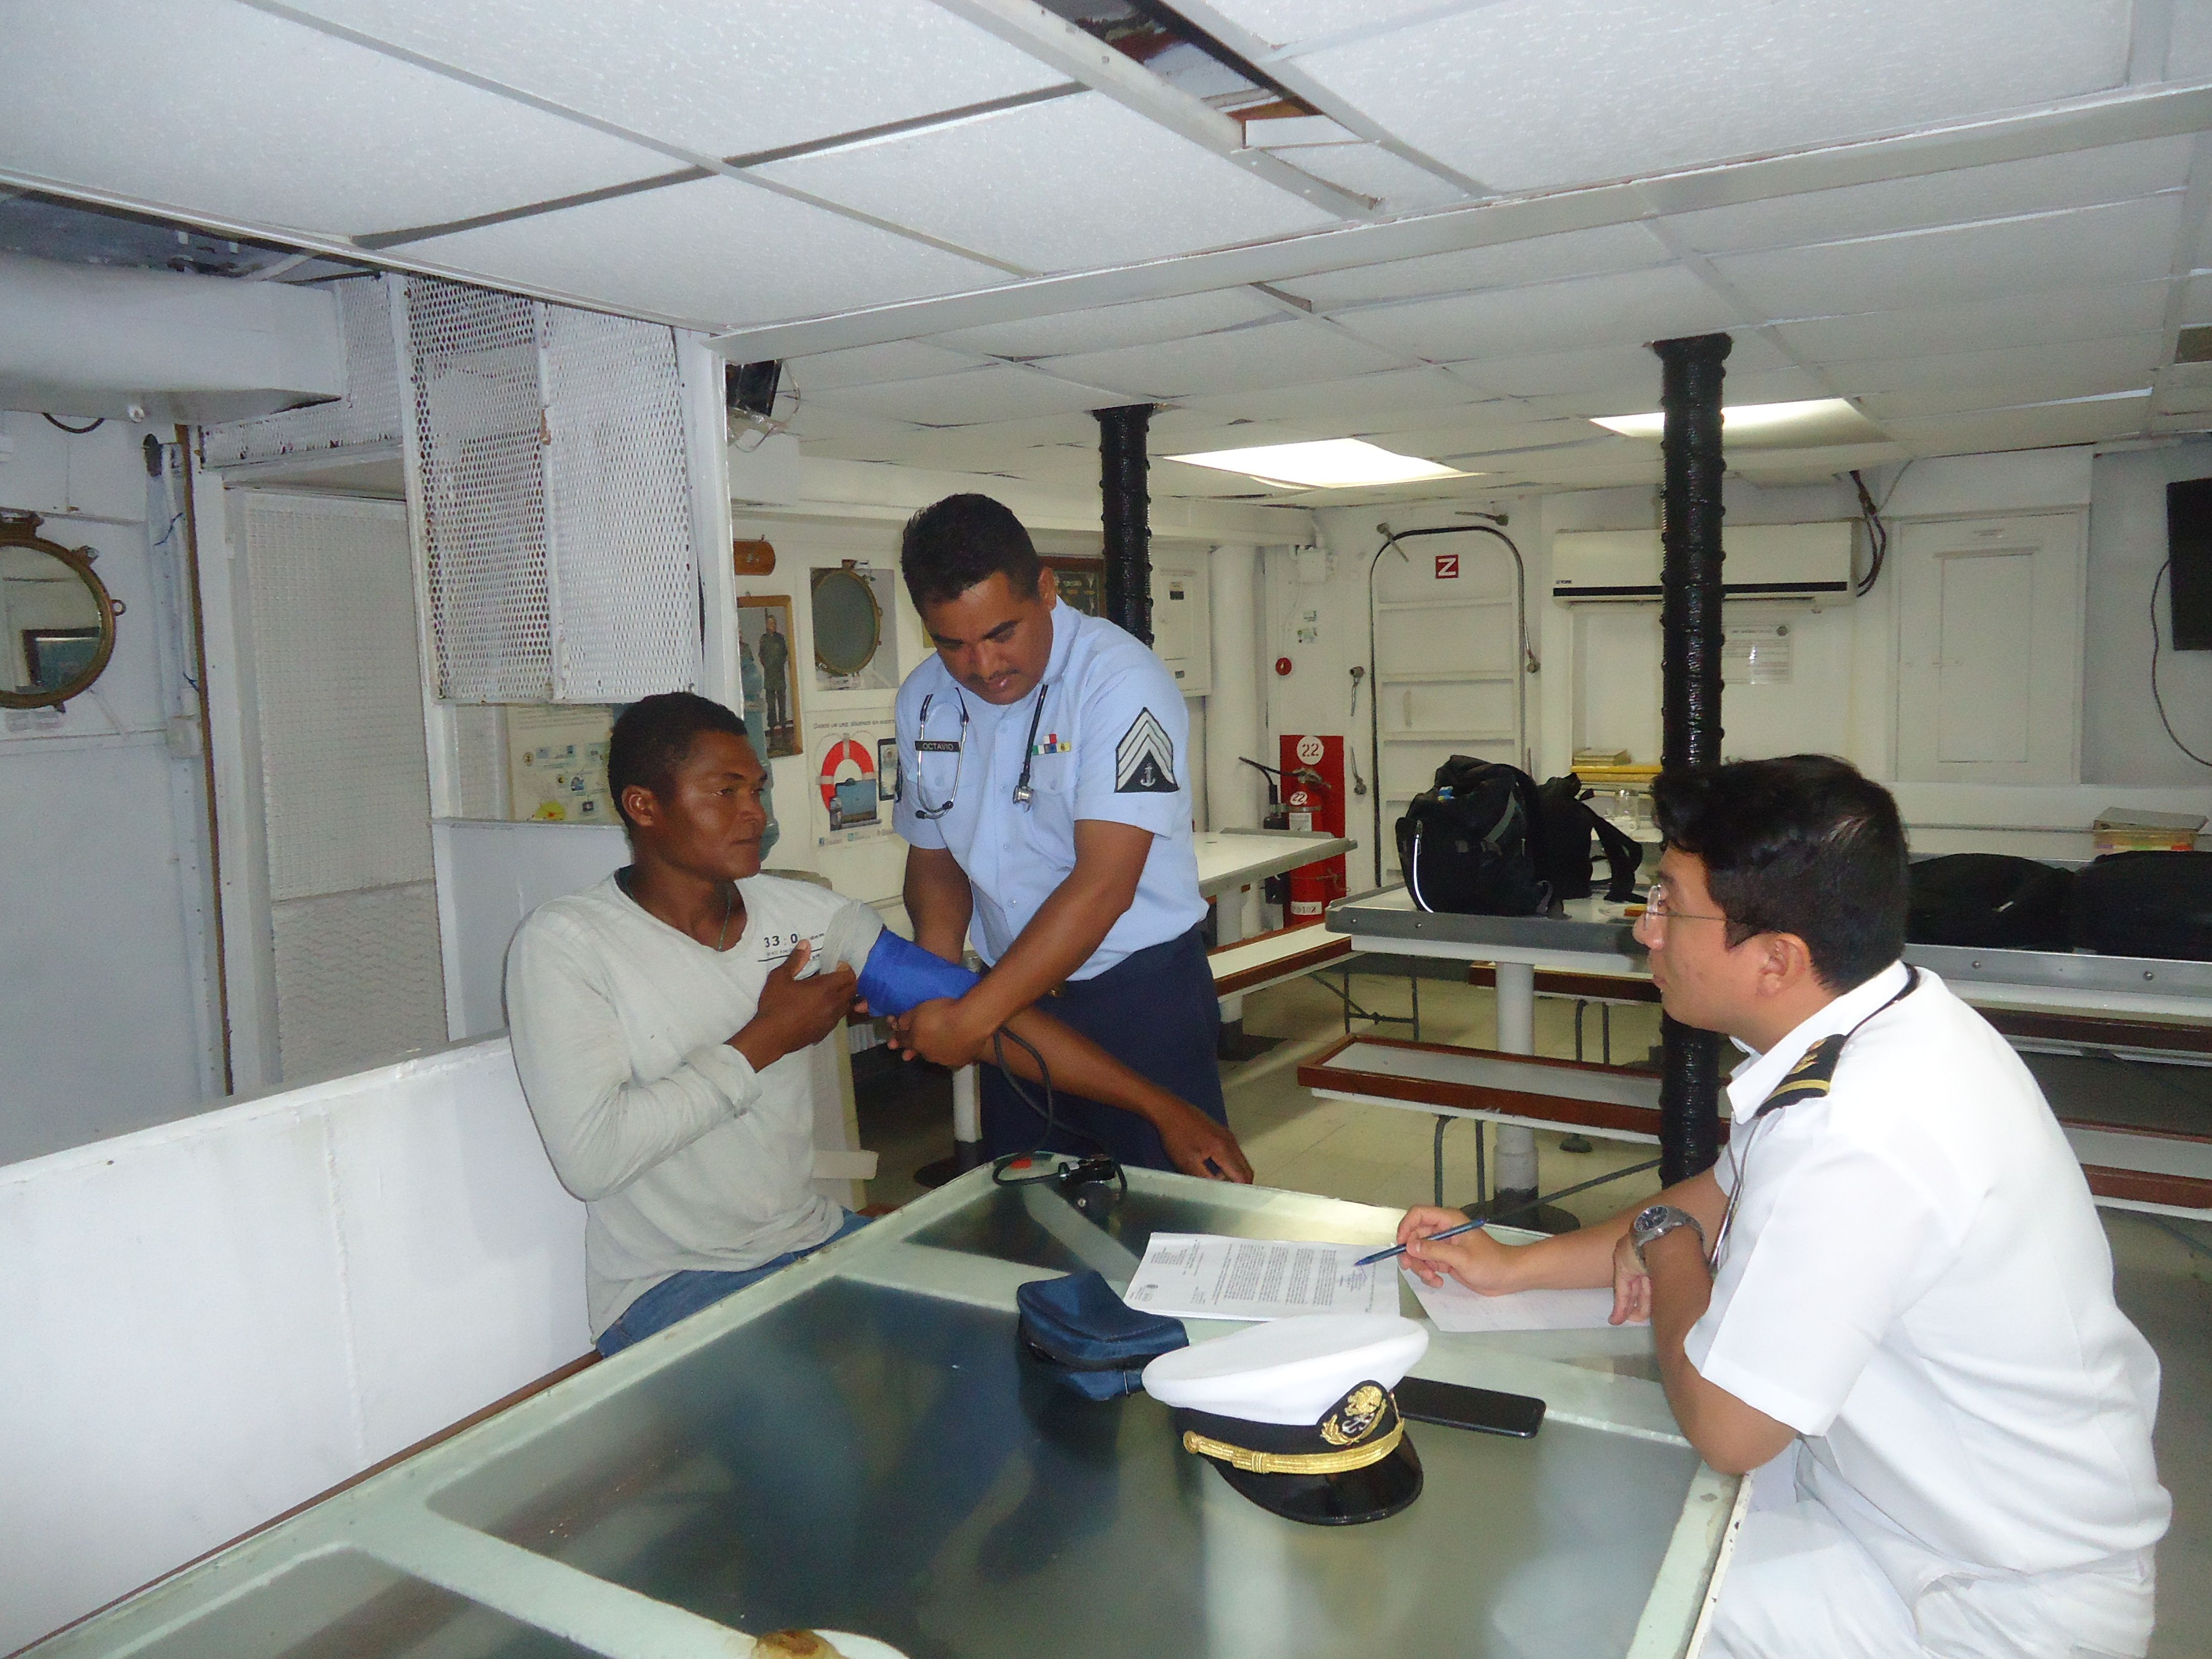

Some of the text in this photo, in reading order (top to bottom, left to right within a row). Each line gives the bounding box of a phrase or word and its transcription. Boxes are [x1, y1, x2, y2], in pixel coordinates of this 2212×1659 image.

[1438, 558, 1456, 576] Z
[922, 742, 954, 751] OCTAVIO
[1302, 743, 1318, 756] 22
[1292, 793, 1305, 801] 22
